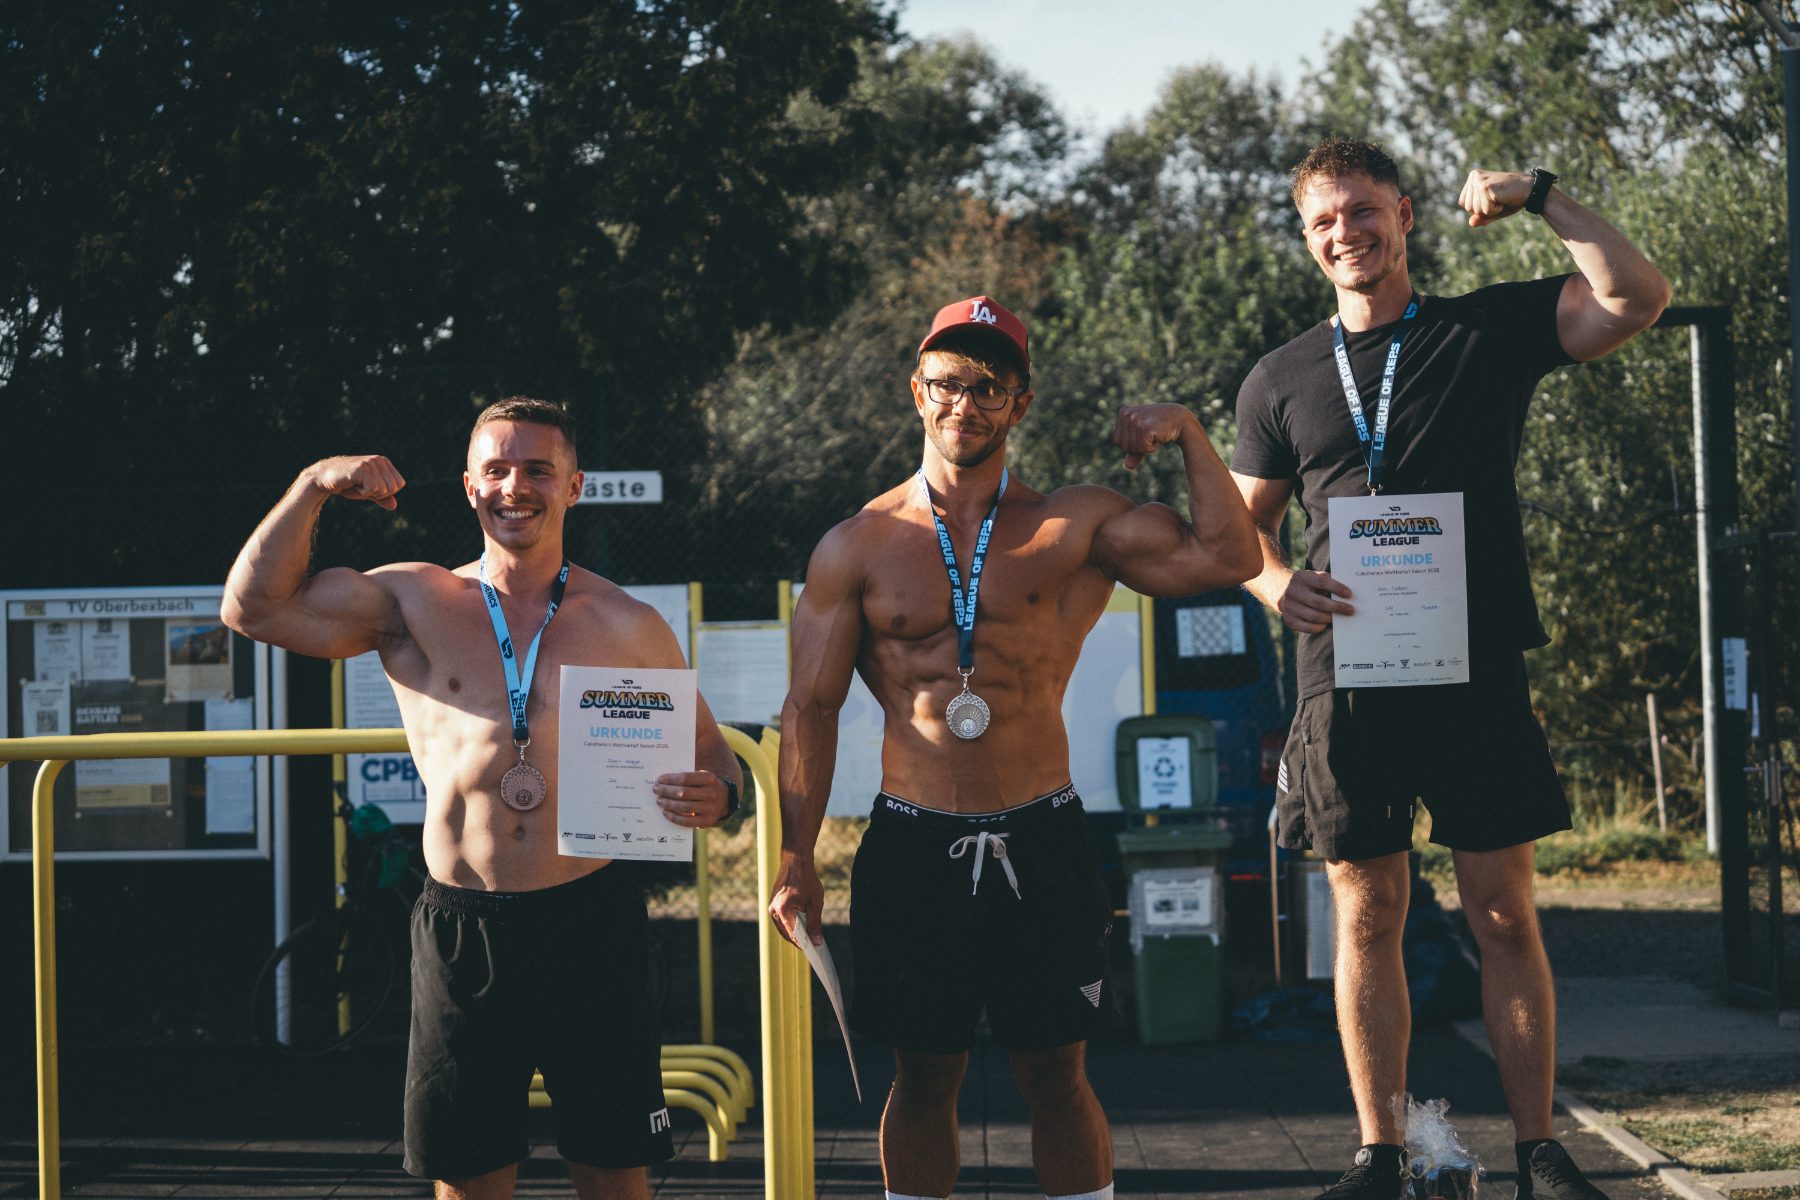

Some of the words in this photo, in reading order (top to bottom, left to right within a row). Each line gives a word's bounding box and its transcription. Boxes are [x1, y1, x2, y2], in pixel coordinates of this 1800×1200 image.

[970, 301, 997, 324] LA
[1335, 344, 1353, 387] LEAGUE
[1386, 342, 1401, 376] REPS
[1346, 388, 1360, 405] OF
[1381, 378, 1394, 395] OF
[1351, 407, 1371, 442] REPS
[1373, 398, 1390, 450] LEAGUE
[584, 477, 645, 497] äste
[976, 519, 993, 553] REPS
[1350, 517, 1442, 539] SUMMER
[934, 516, 956, 565] LEAGUE
[1373, 537, 1420, 546] LEAGUE
[972, 556, 984, 574] OF
[1361, 553, 1433, 567] URKUNDE
[948, 569, 961, 585] OF
[68, 601, 88, 613] TV
[92, 600, 195, 613] Oberbexbach
[953, 589, 965, 626] REPS
[963, 577, 979, 631] LEAGUE
[580, 690, 674, 711] SUMMER
[603, 710, 650, 719] LEAGUE
[590, 726, 663, 740] URKUNDE
